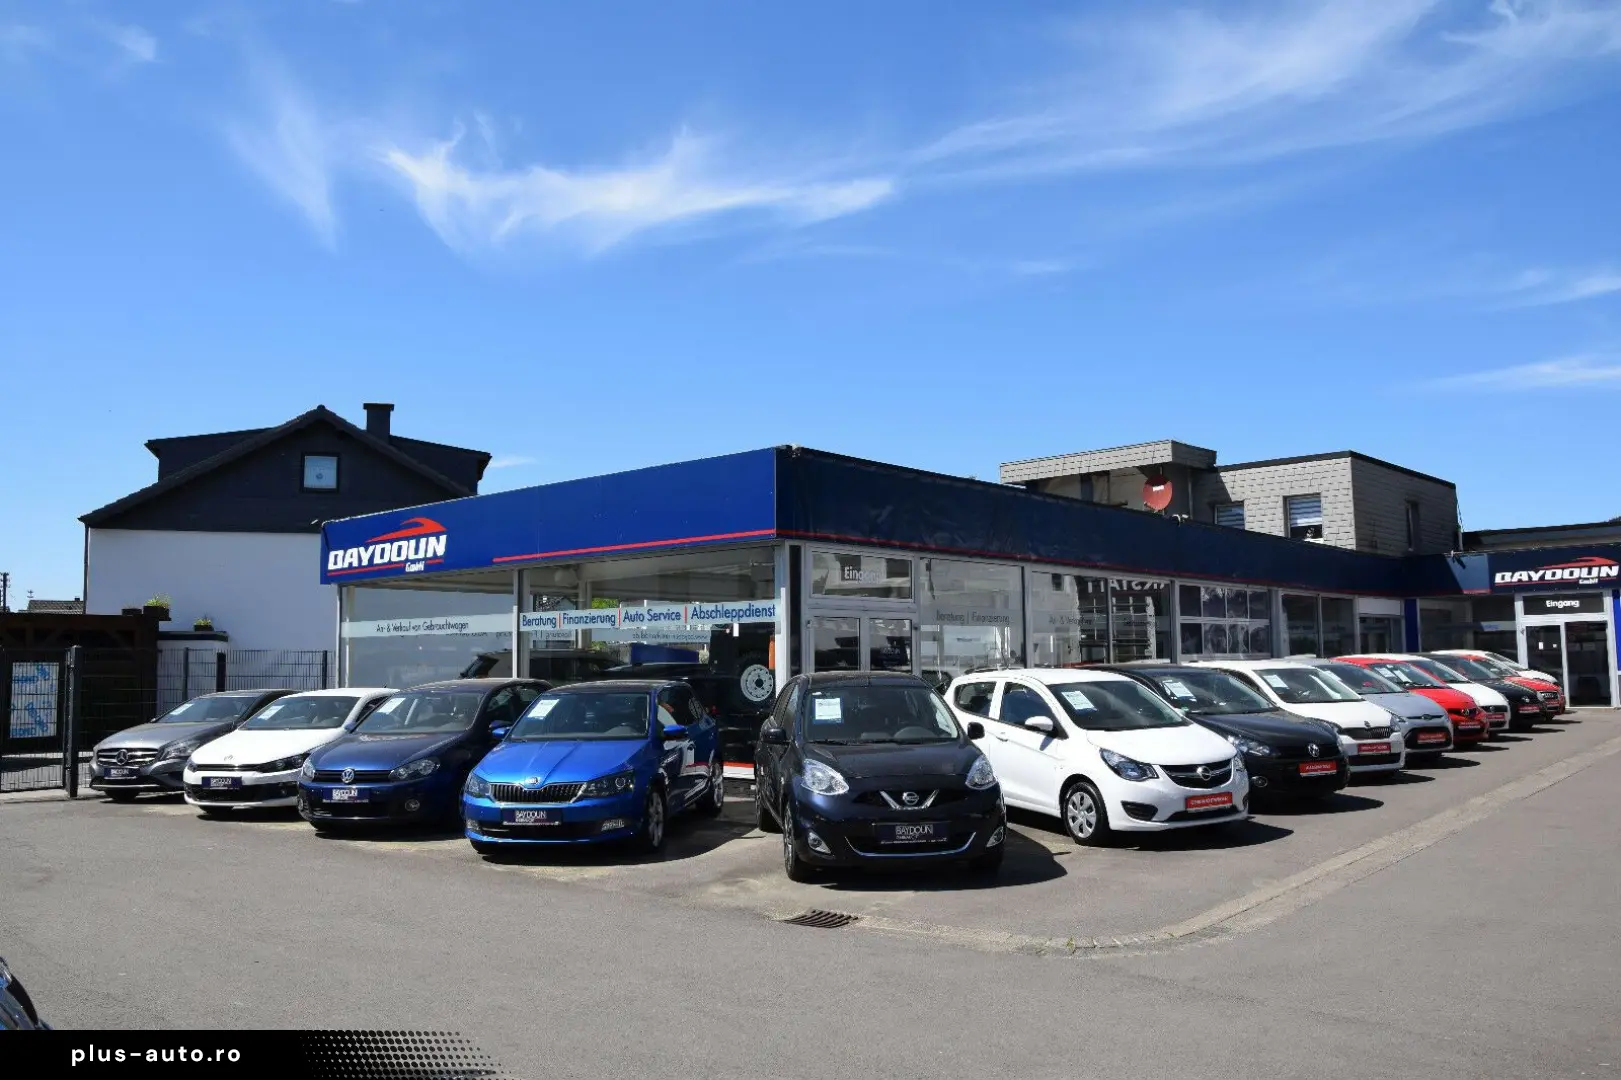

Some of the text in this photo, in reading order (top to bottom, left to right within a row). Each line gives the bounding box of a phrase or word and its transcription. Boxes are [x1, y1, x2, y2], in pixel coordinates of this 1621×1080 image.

[1546, 600, 1580, 609] Eingang
[522, 602, 776, 629] Beratung Finanzierung Auto Service Abschleppdienst
